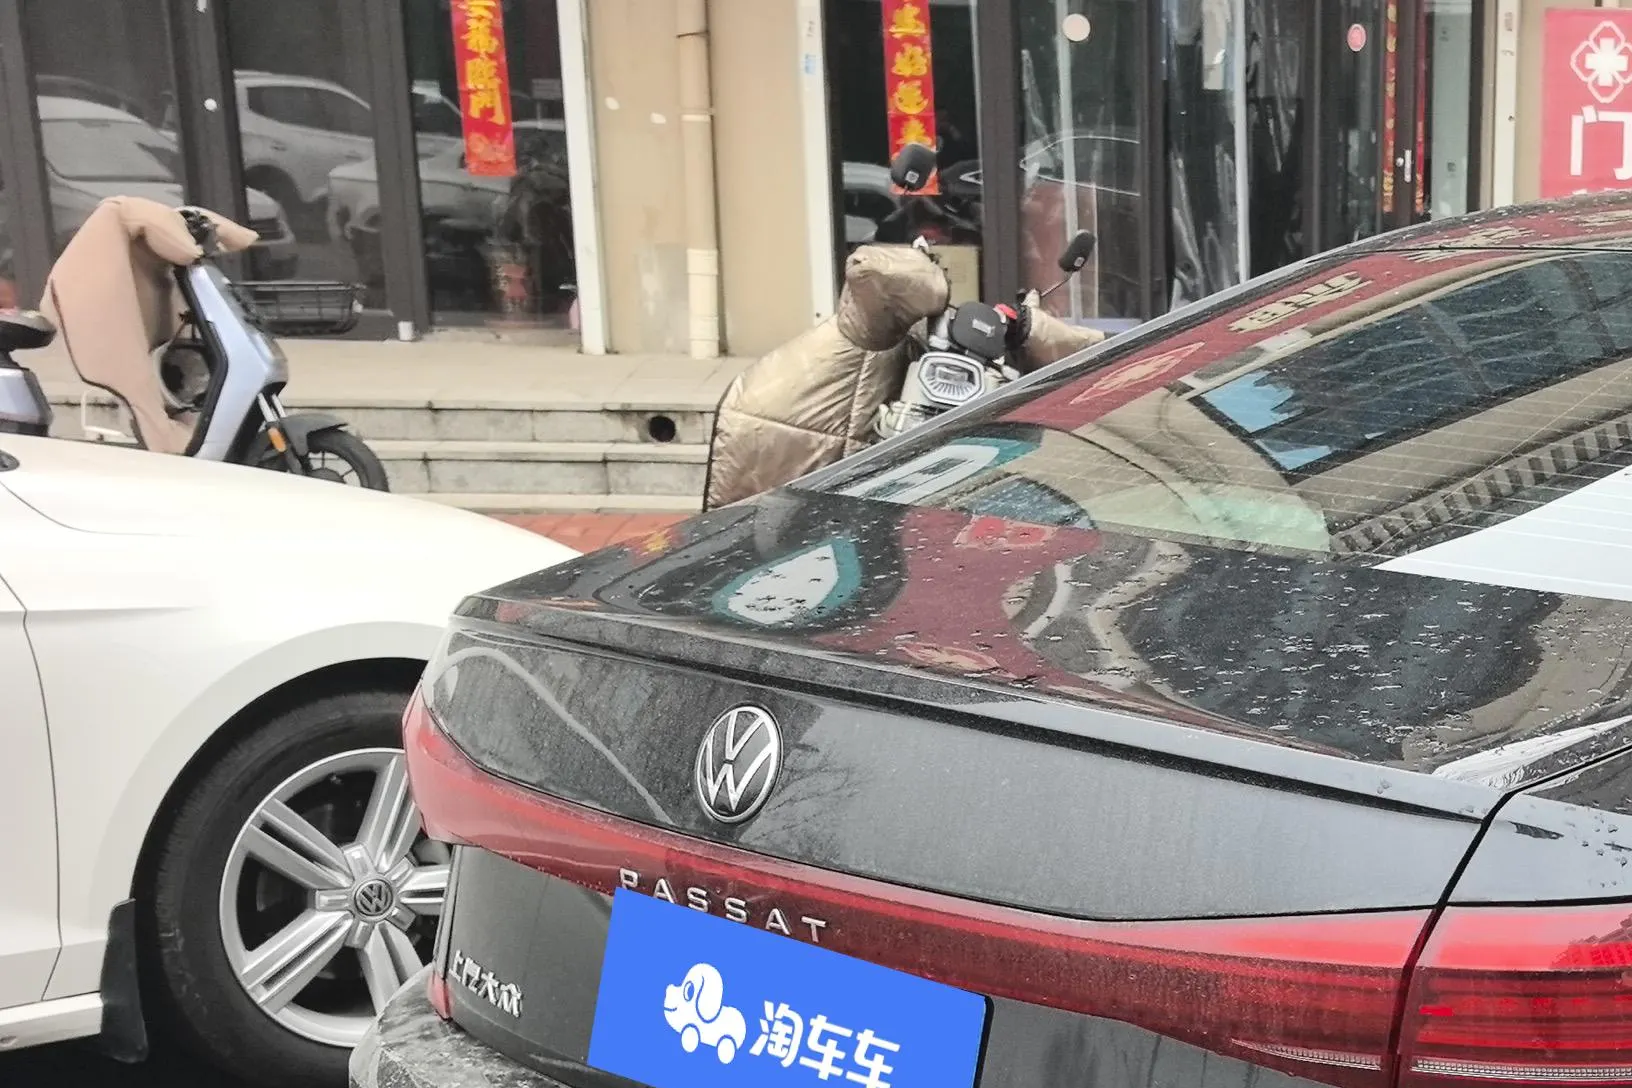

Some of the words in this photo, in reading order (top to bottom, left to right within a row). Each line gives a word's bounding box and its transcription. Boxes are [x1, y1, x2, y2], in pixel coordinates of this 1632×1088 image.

[619, 867, 827, 943] PASSAT
[448, 949, 522, 1018] 上汽大众
